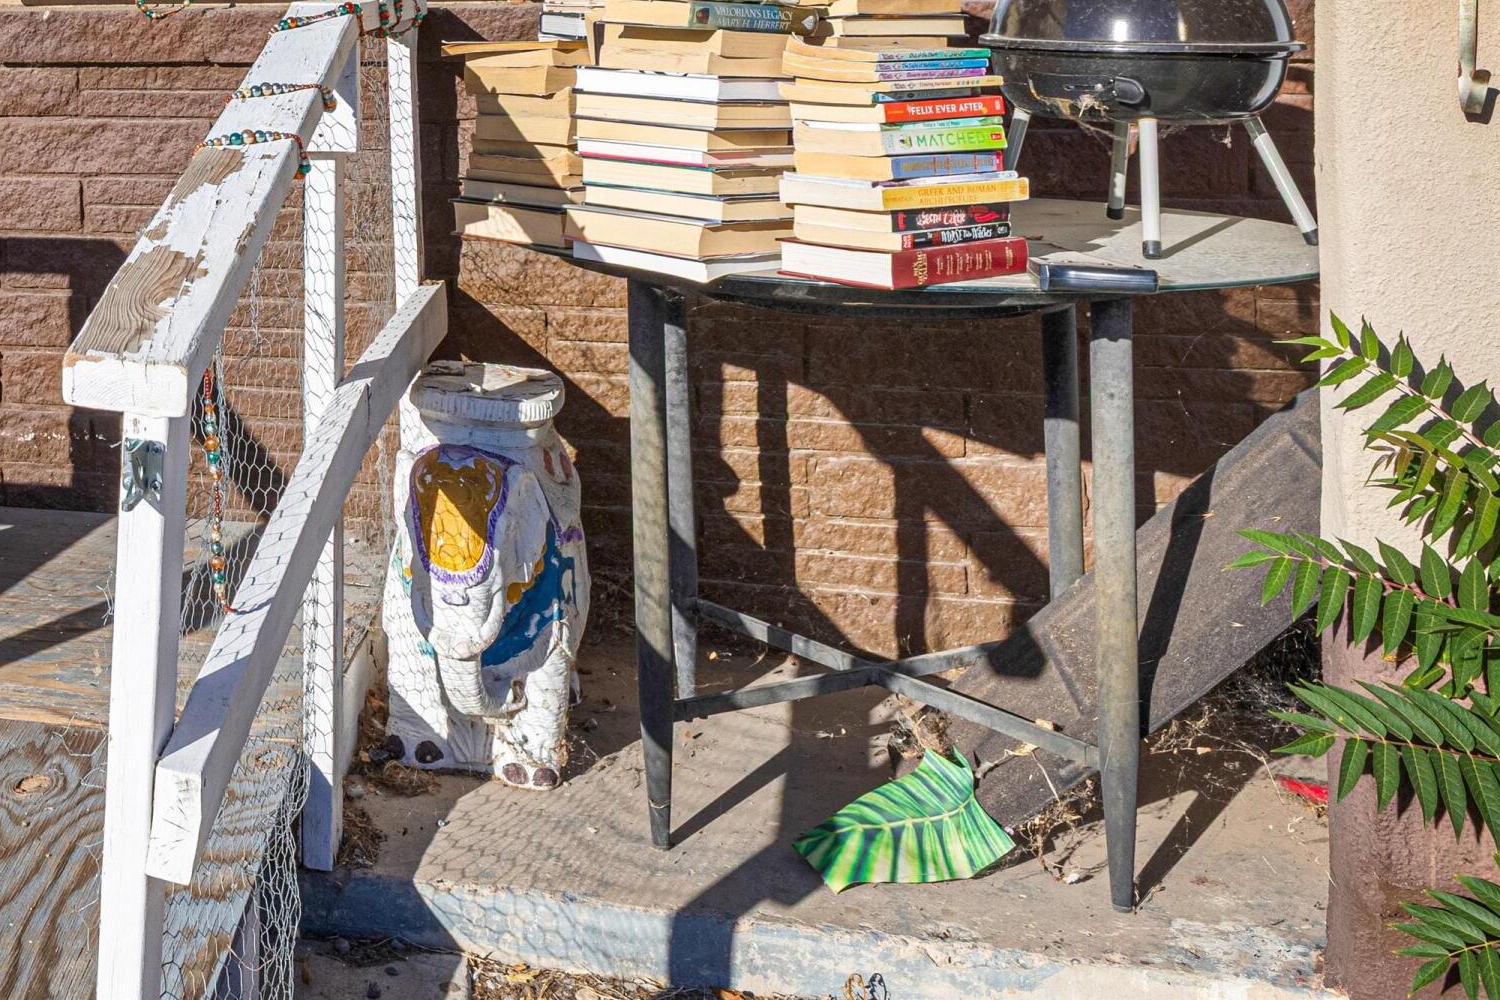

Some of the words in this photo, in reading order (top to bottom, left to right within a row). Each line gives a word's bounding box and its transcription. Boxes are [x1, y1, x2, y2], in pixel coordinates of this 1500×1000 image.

[715, 6, 761, 19] VALORIAN'S
[762, 9, 793, 21] LEGACY
[718, 17, 741, 27] MARY
[753, 20, 791, 31] HERBERT
[911, 105, 934, 115] FELIX
[936, 104, 956, 114] EVER
[959, 102, 983, 112] AFTER
[916, 131, 987, 147] MATCHED
[918, 186, 943, 195] GREEK
[947, 186, 964, 194] AND
[967, 184, 997, 193] ROMAN
[919, 195, 979, 205] ARCHITECTURE
